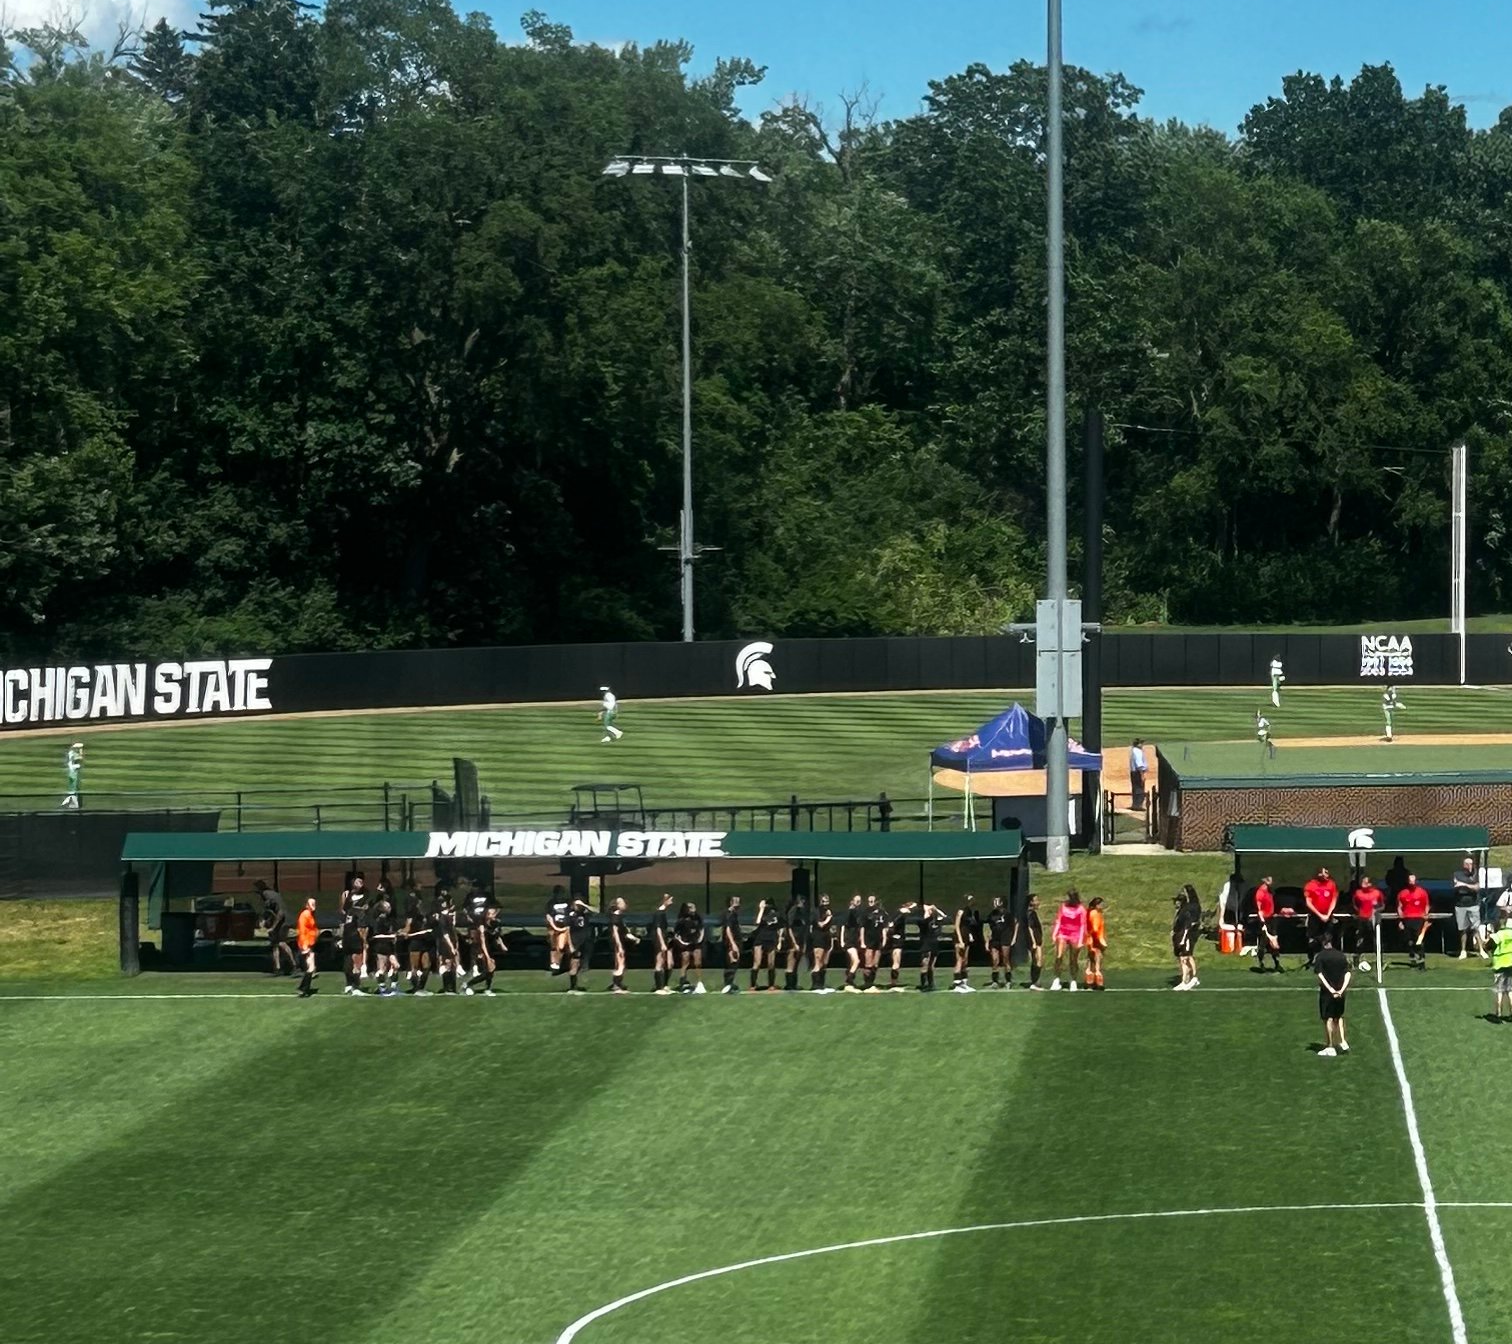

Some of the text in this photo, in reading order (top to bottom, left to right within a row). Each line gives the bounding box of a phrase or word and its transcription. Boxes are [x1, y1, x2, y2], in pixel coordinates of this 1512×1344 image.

[1361, 635, 1413, 653] NCAA
[154, 659, 273, 714] STATE
[425, 830, 728, 856] MICHIGAN STATE
